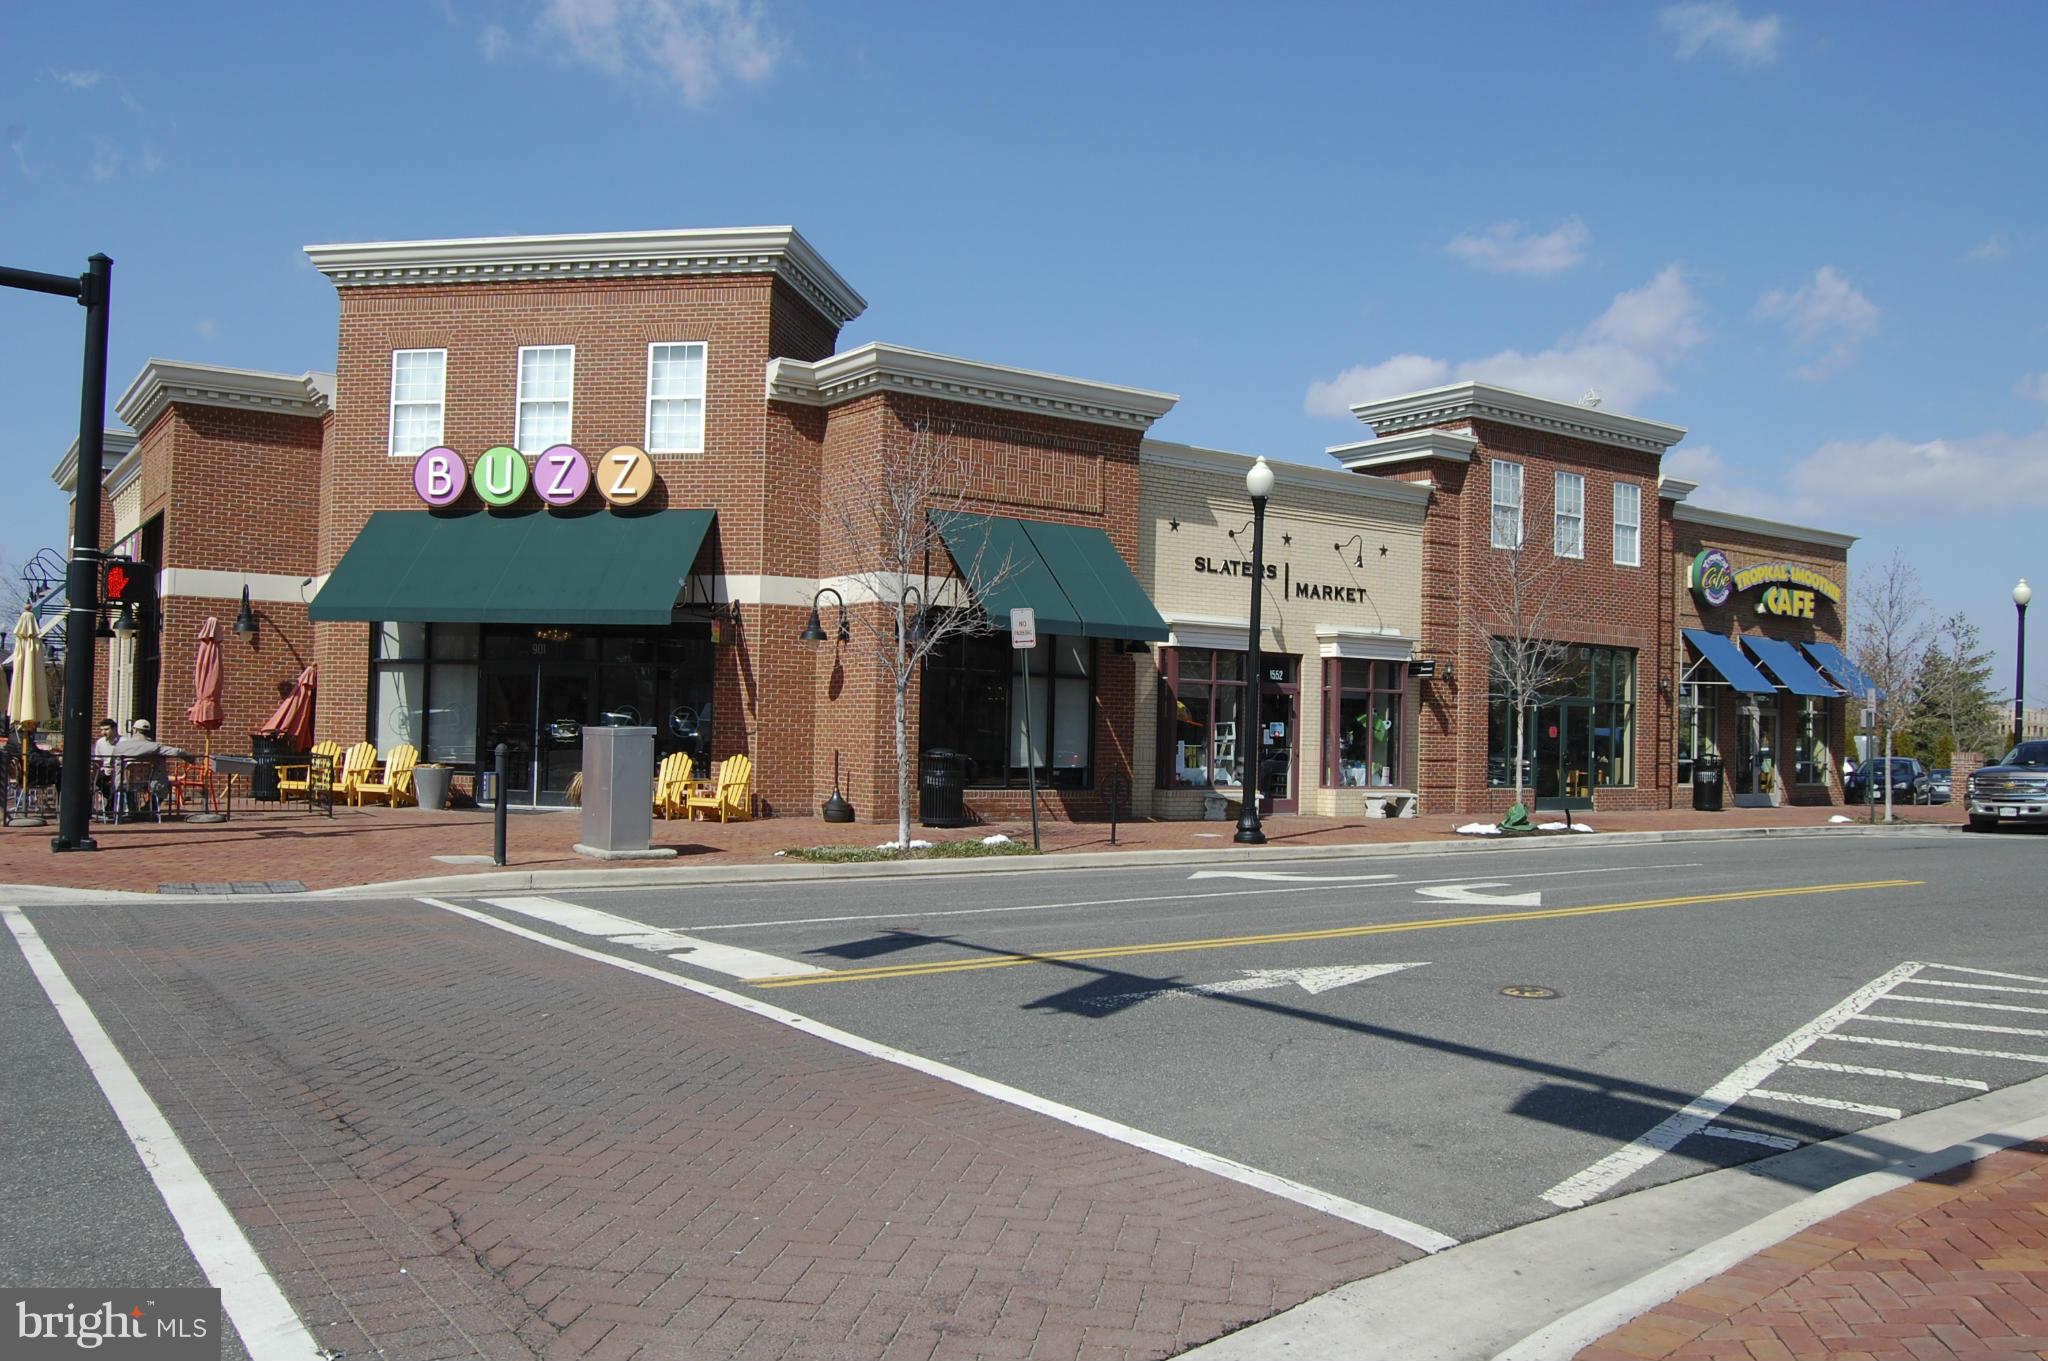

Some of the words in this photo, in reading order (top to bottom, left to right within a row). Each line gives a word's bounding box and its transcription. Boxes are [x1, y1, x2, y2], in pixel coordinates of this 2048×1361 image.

[428, 455, 639, 496] BUZZ
[1734, 562, 1789, 592] TROPICAL
[1295, 582, 1367, 604] MARKET
[1767, 586, 1815, 619] CAFE
[1269, 669, 1284, 681] 1552
